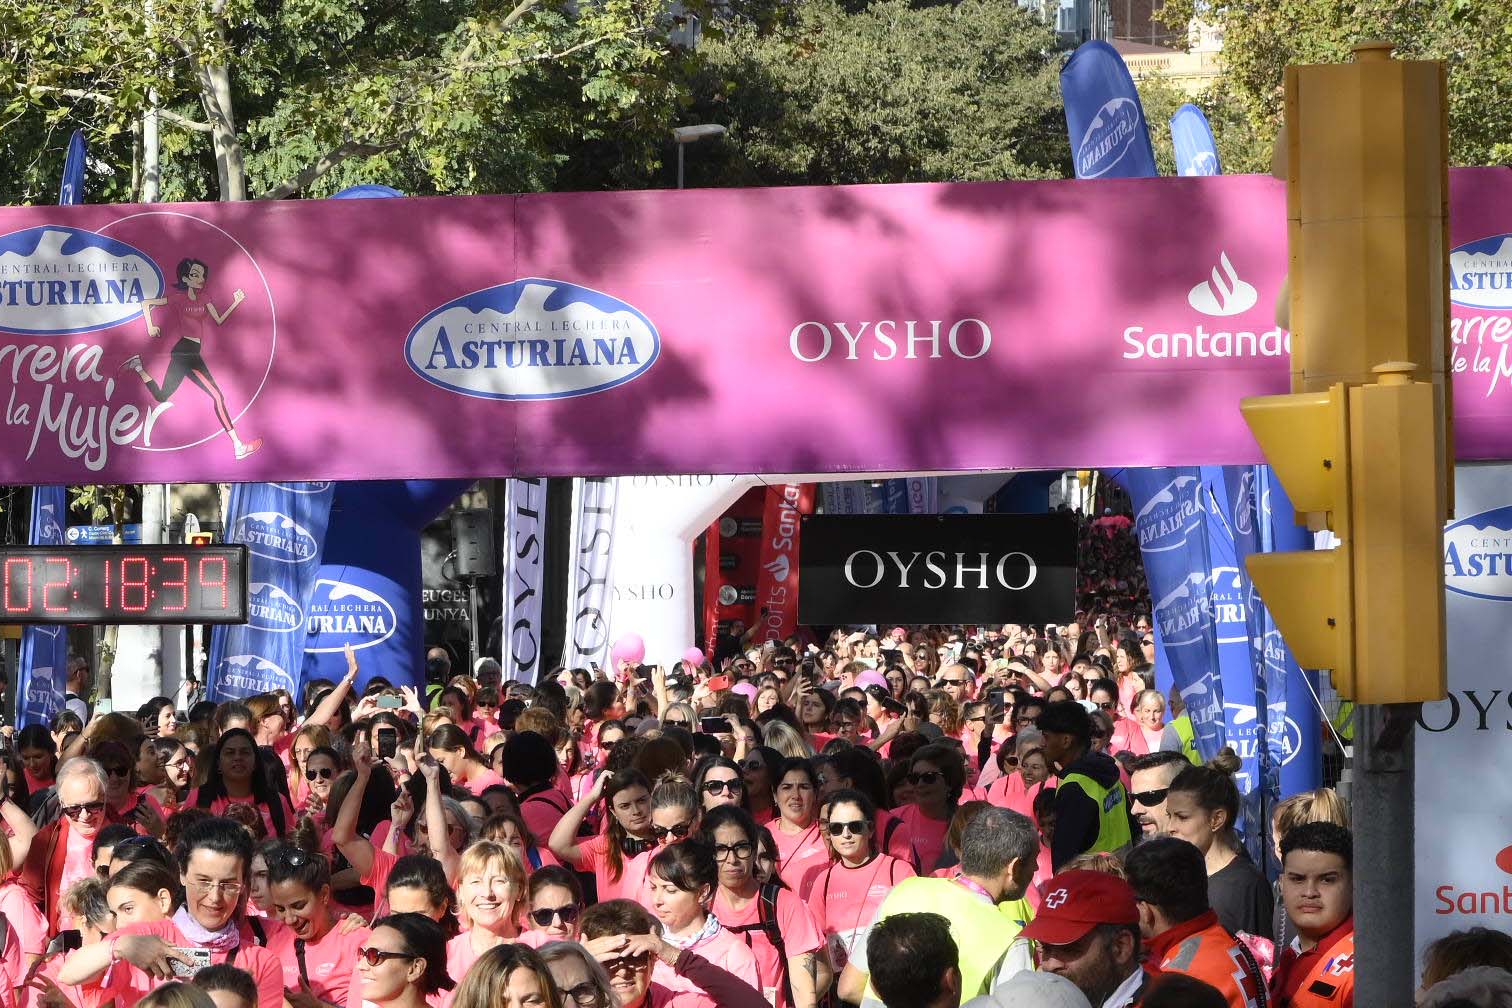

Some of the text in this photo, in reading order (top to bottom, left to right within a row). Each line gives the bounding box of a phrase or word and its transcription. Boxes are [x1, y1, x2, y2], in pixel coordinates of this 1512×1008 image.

[67, 262, 140, 273] LECHERA
[1464, 259, 1512, 268] CENTRA
[464, 319, 631, 333] CENTRAL LECHERA
[789, 318, 993, 363] OYSHO
[424, 325, 640, 371] ASTURIANA
[5, 389, 31, 426] la
[24, 378, 174, 472] Mujer
[235, 525, 309, 557] ASTURIANA
[4, 557, 228, 613] 02:18:39
[844, 549, 1038, 591] OYSHO
[333, 605, 383, 613] LECHERA
